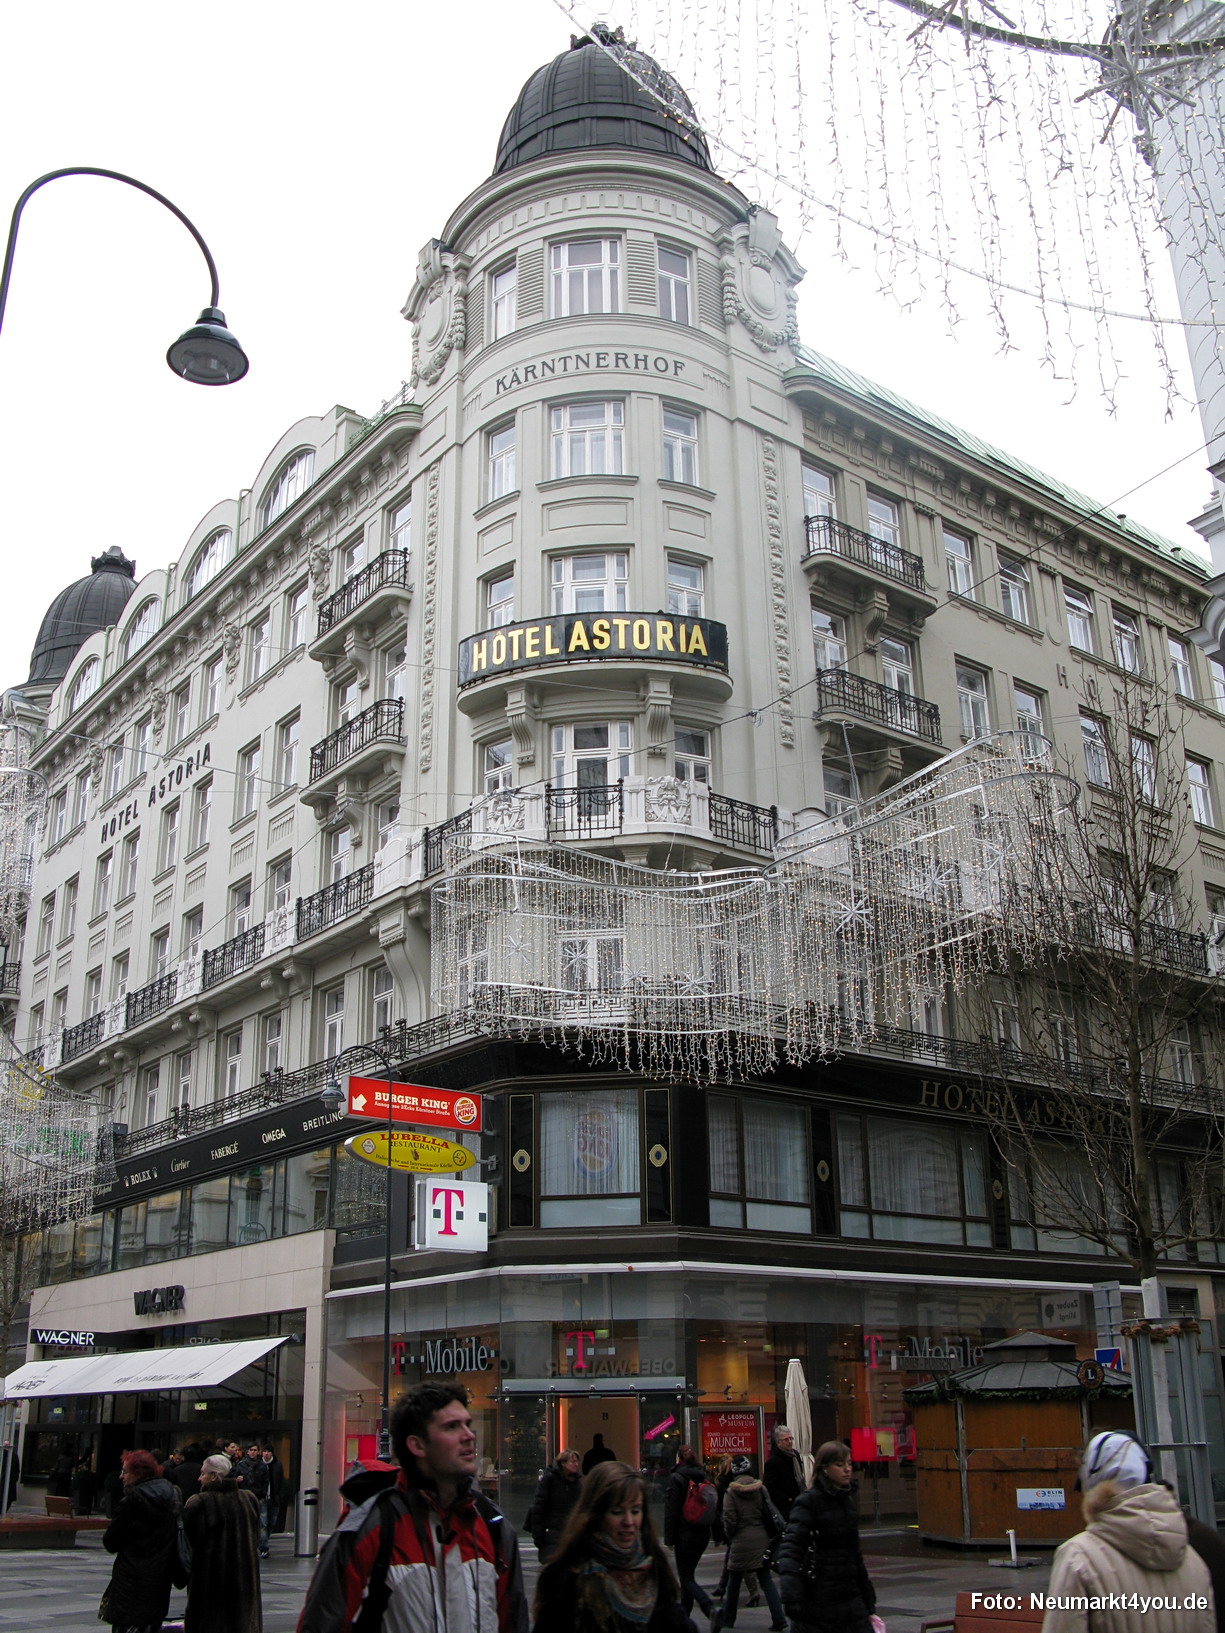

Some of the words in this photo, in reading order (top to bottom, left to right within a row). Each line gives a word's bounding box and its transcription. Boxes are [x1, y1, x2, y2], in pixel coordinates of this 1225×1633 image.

[495, 352, 686, 396] KÄRNTNERHOF
[568, 618, 708, 656] ASTORIA
[148, 742, 211, 808] ASTORIA
[374, 1091, 419, 1106] BURGER
[421, 1098, 448, 1110] KING
[456, 1103, 474, 1111] BURGER
[919, 1079, 1018, 1121] HOTEL
[1025, 1098, 1130, 1136] ASTORI
[457, 1108, 475, 1117] KING
[262, 1127, 287, 1145] OMEGA
[380, 1133, 450, 1149] LUBELLA
[211, 1140, 240, 1161] FABERGÉ
[388, 1141, 443, 1154] RESTAURANT
[170, 1157, 191, 1174] Cartier
[131, 1169, 152, 1186] ROLEX
[432, 1187, 465, 1236] T
[36, 1329, 95, 1346] WAGNER
[425, 1336, 491, 1374] Mobile
[565, 1331, 595, 1369] T
[908, 1335, 985, 1370] Mobile
[710, 1436, 745, 1448] MUNCH
